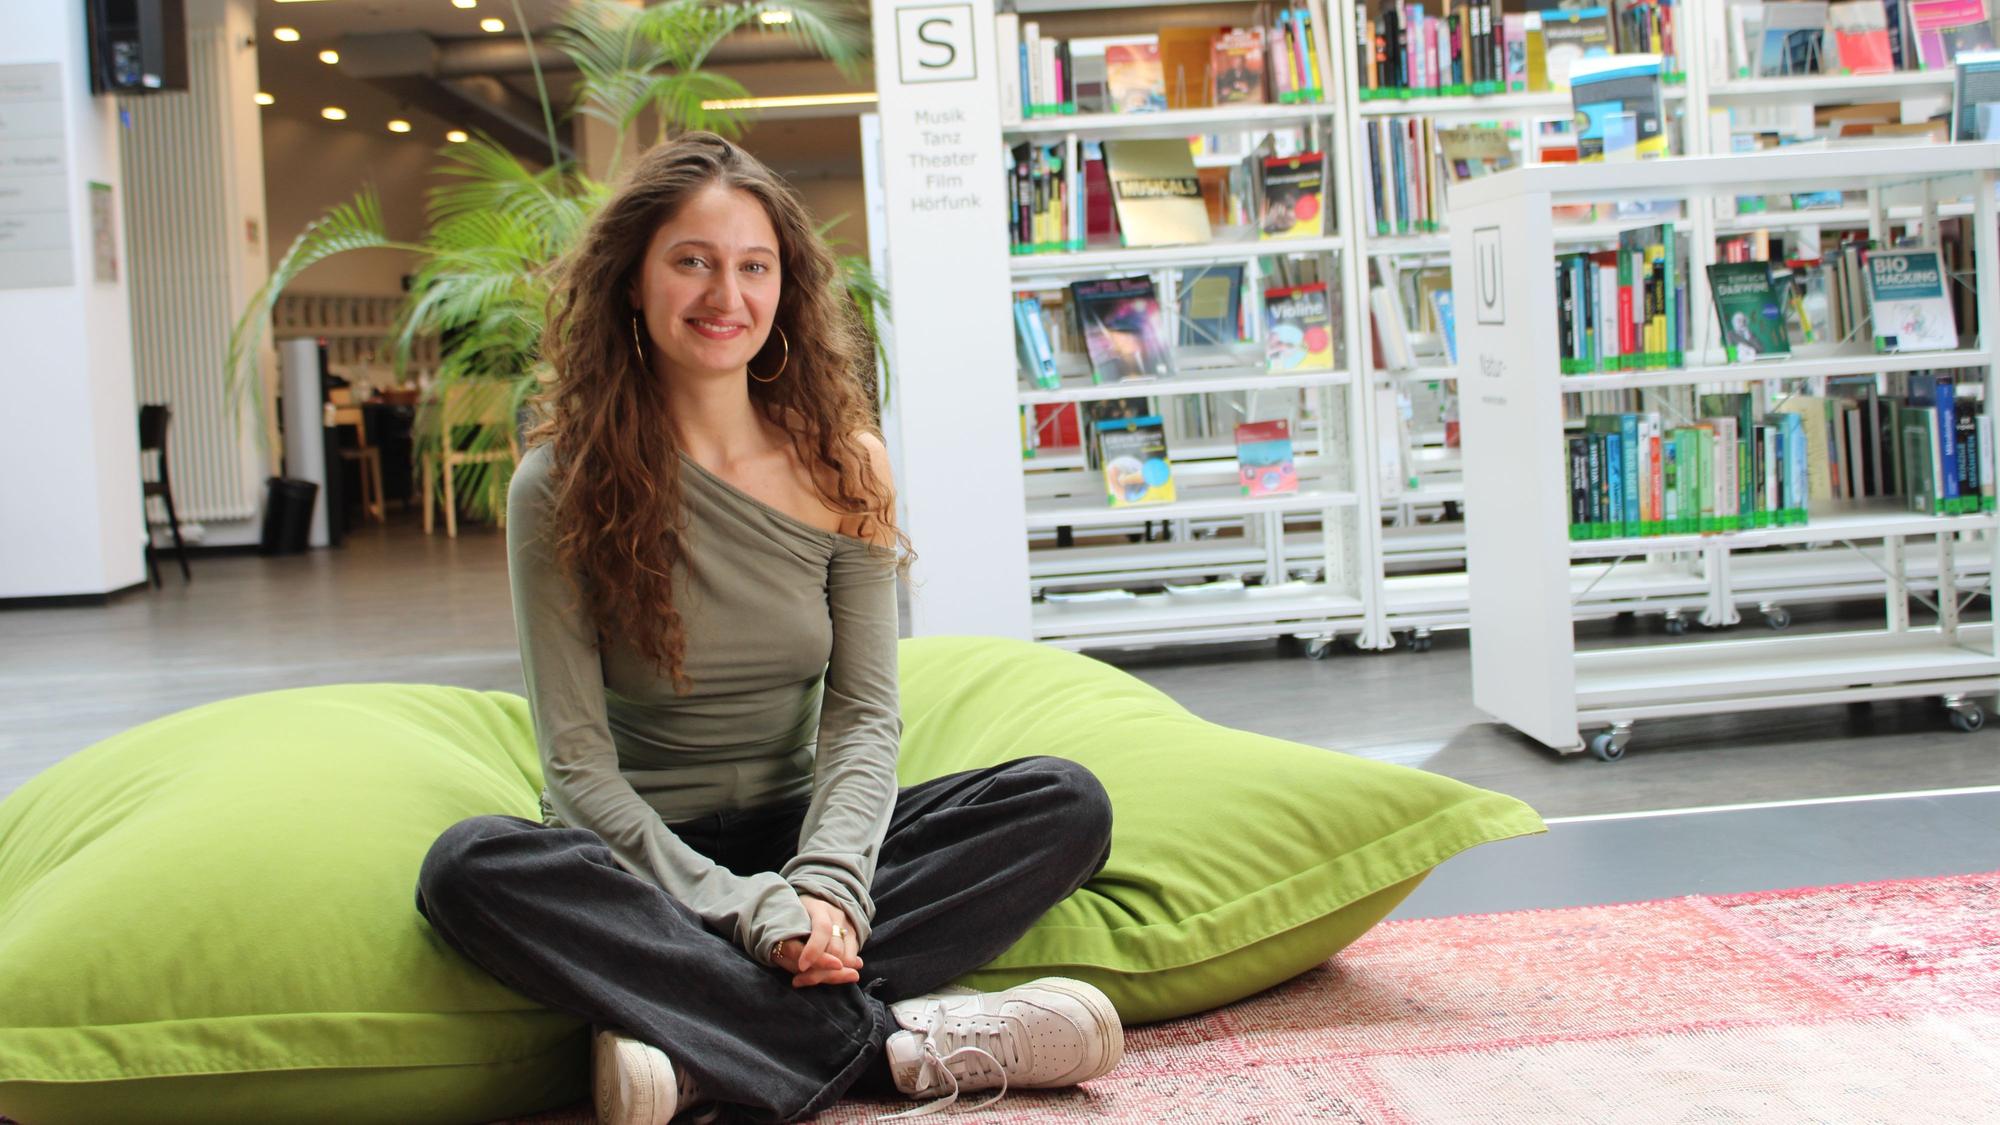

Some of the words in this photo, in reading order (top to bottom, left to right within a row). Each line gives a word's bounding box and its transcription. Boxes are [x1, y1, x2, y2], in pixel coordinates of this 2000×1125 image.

[918, 17, 956, 69] S
[914, 108, 966, 126] Musik
[920, 131, 962, 147] Tanz
[907, 152, 978, 169] Theater
[925, 173, 964, 190] Film
[1120, 178, 1198, 198] MUSICALS
[911, 192, 983, 212] Hörfunk
[1872, 255, 1909, 274] BIO
[1479, 242, 1497, 310] U
[1875, 270, 1939, 286] HACKING
[1269, 302, 1325, 320] Violine
